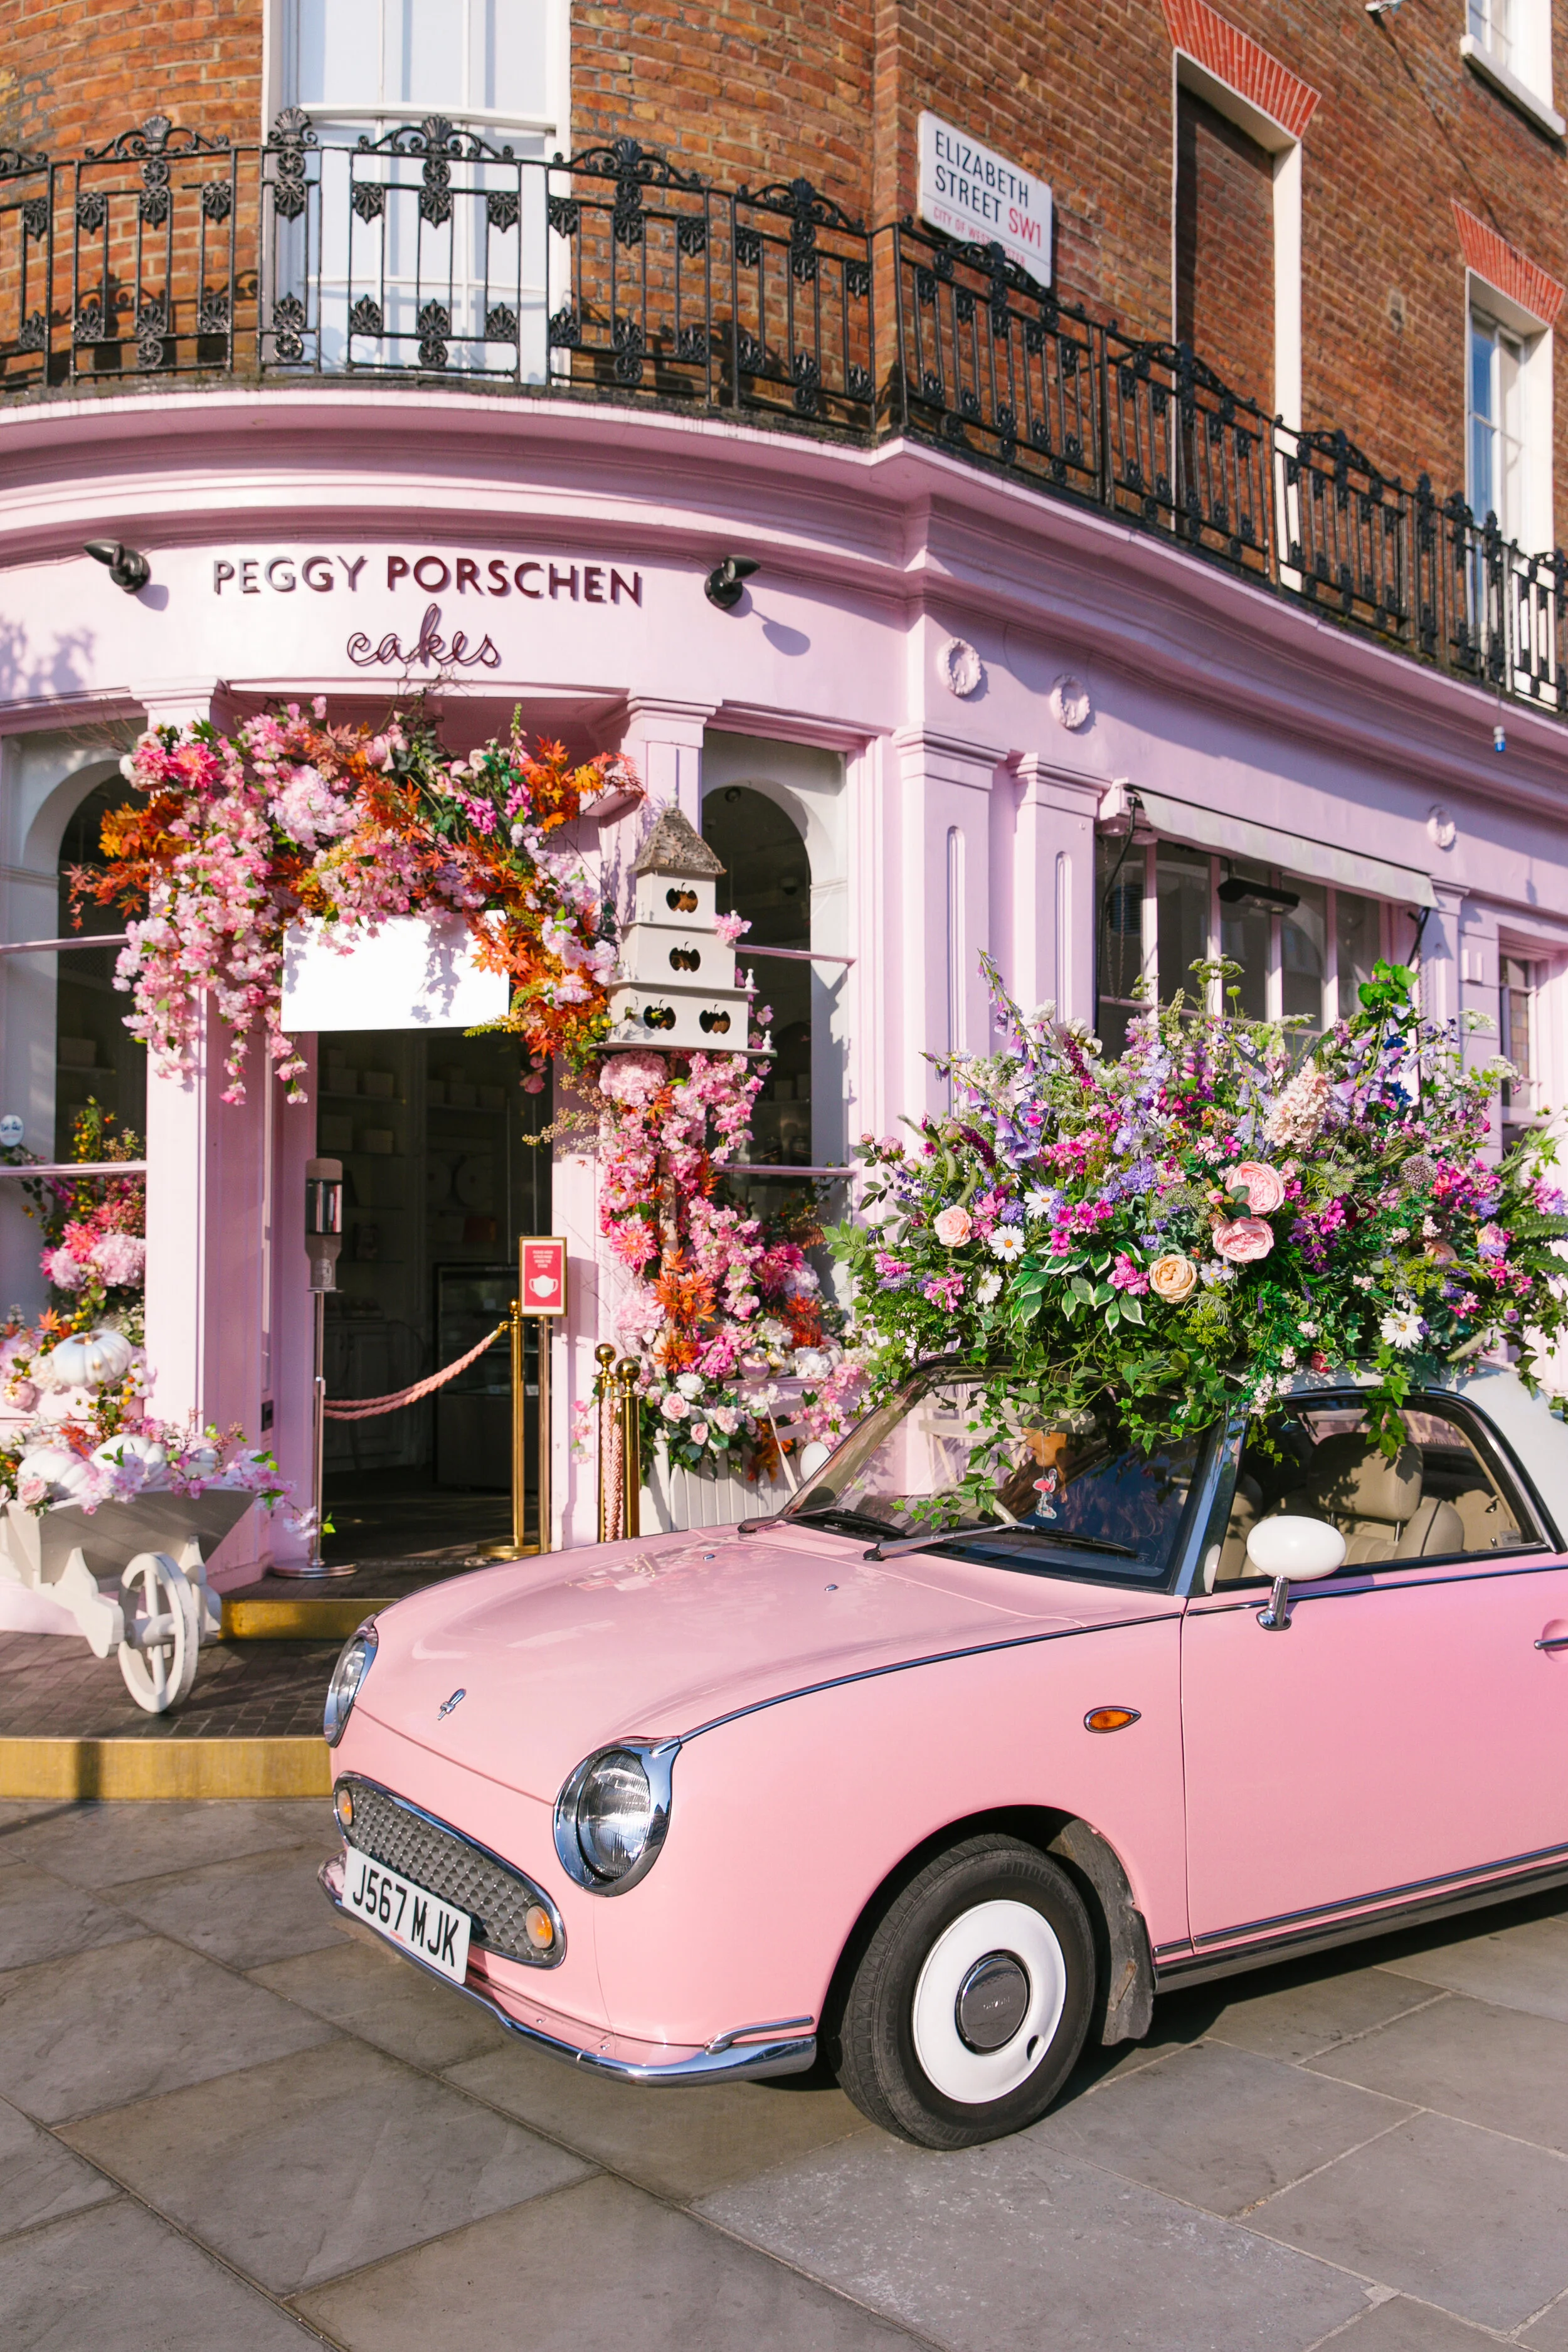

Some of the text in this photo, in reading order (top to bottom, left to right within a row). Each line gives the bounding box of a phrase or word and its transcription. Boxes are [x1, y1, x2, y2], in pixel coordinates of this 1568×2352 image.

[936, 130, 1029, 208] ELIZABETH
[933, 207, 952, 227] CITY
[955, 219, 966, 234] OF
[935, 164, 1042, 250] STREET SW1
[213, 555, 643, 608] PEGGY PORSCHEN
[346, 603, 502, 668] cakes
[352, 1863, 460, 1968] J567 MJK
